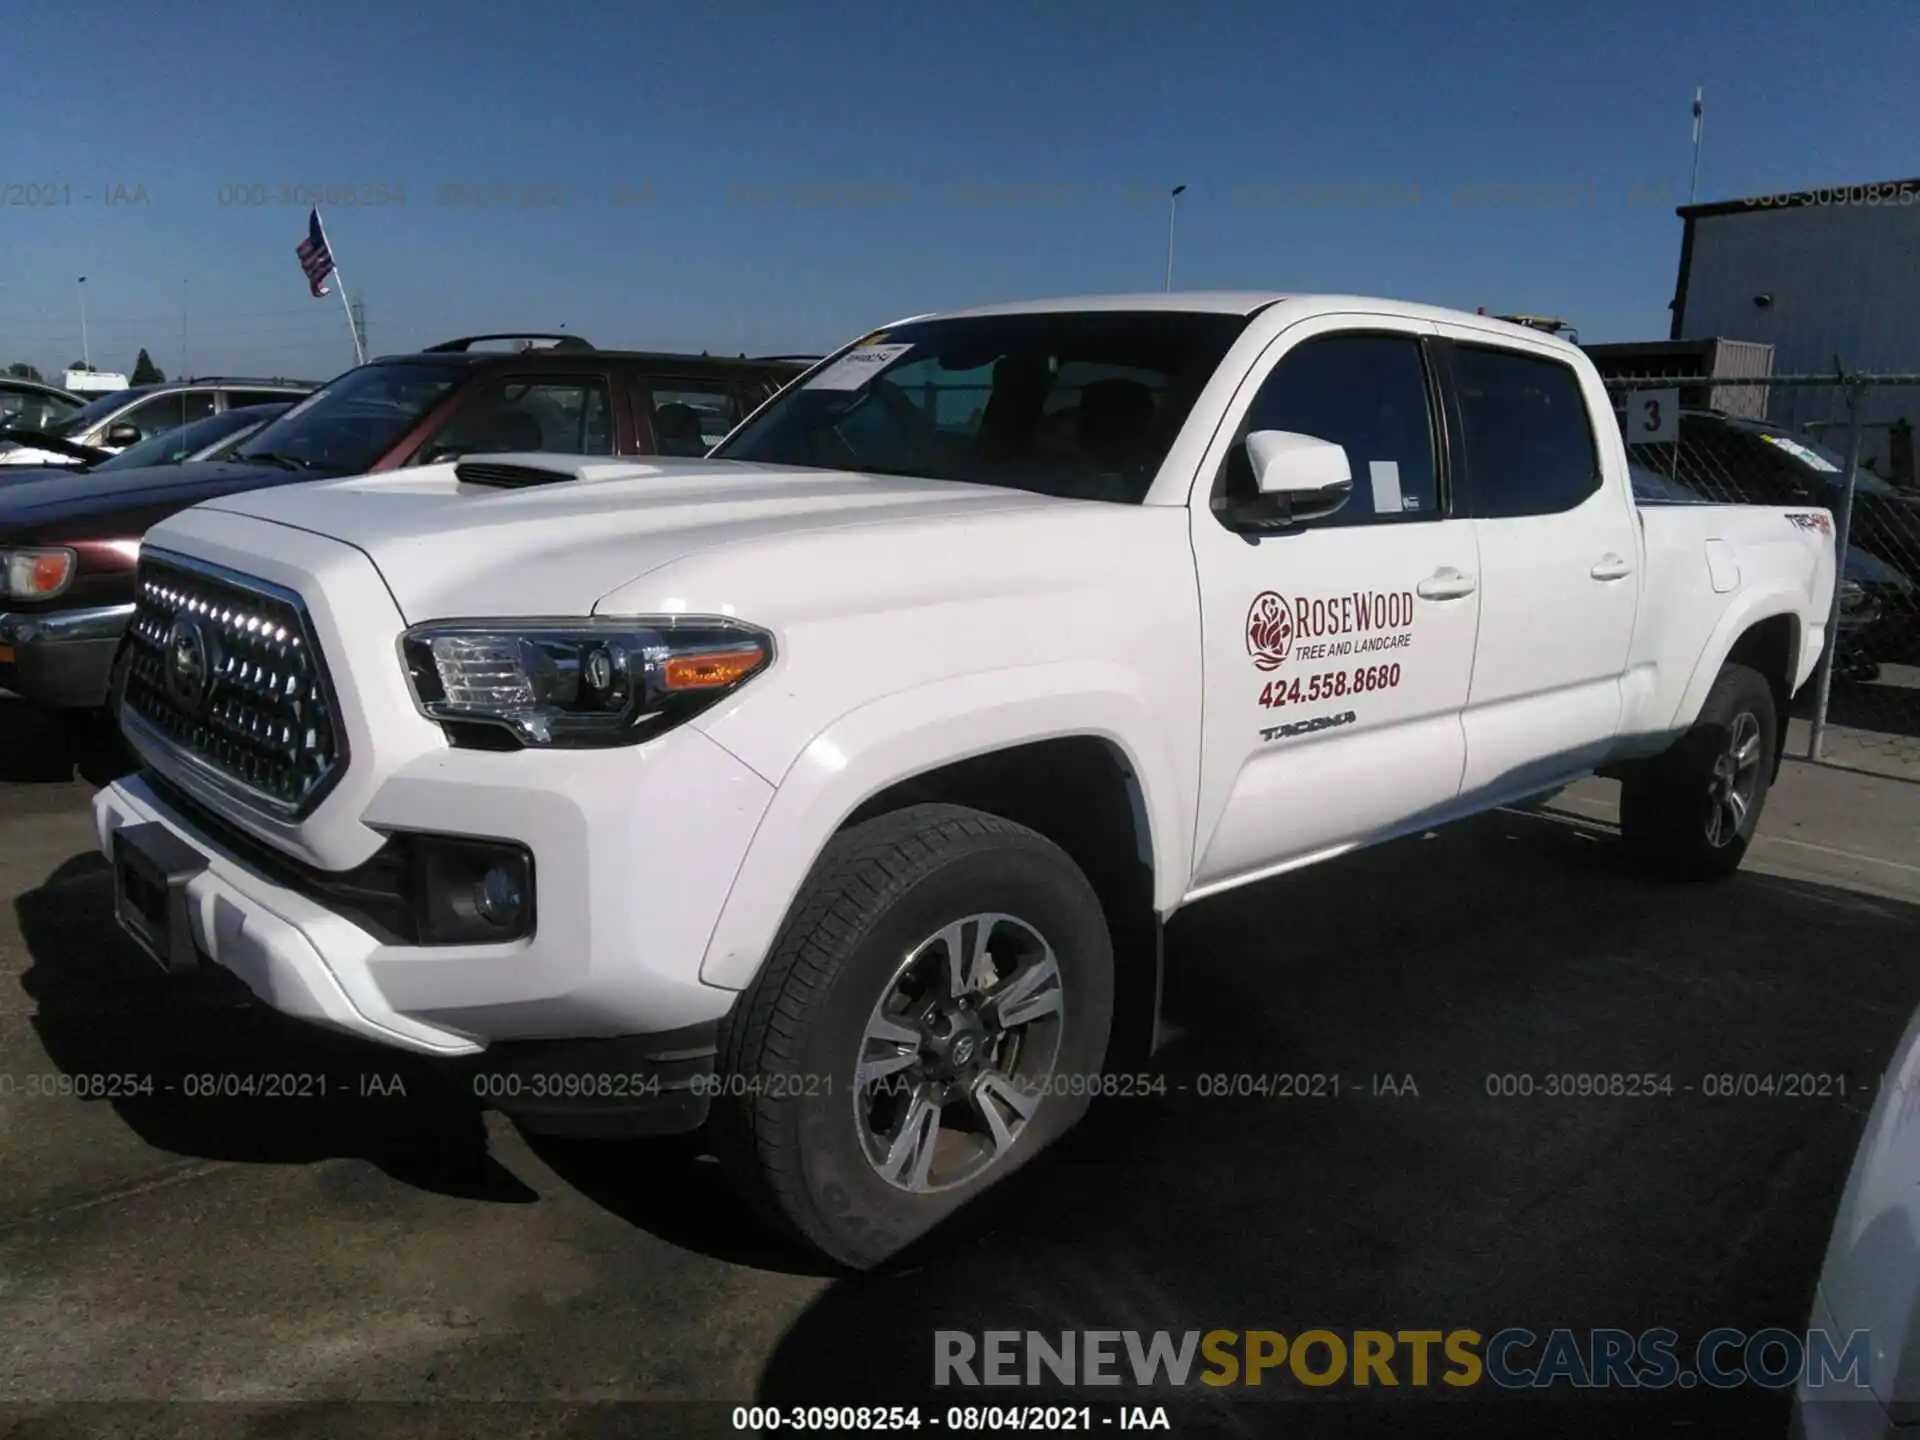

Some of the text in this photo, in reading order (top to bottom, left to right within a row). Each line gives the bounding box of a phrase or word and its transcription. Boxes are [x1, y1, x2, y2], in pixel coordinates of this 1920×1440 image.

[1642, 399, 1661, 432] 3
[1295, 633, 1412, 661] TREE AND LANDCARE
[1258, 663, 1401, 709] 424.558.8680
[1259, 710, 1357, 742] TACOMA
